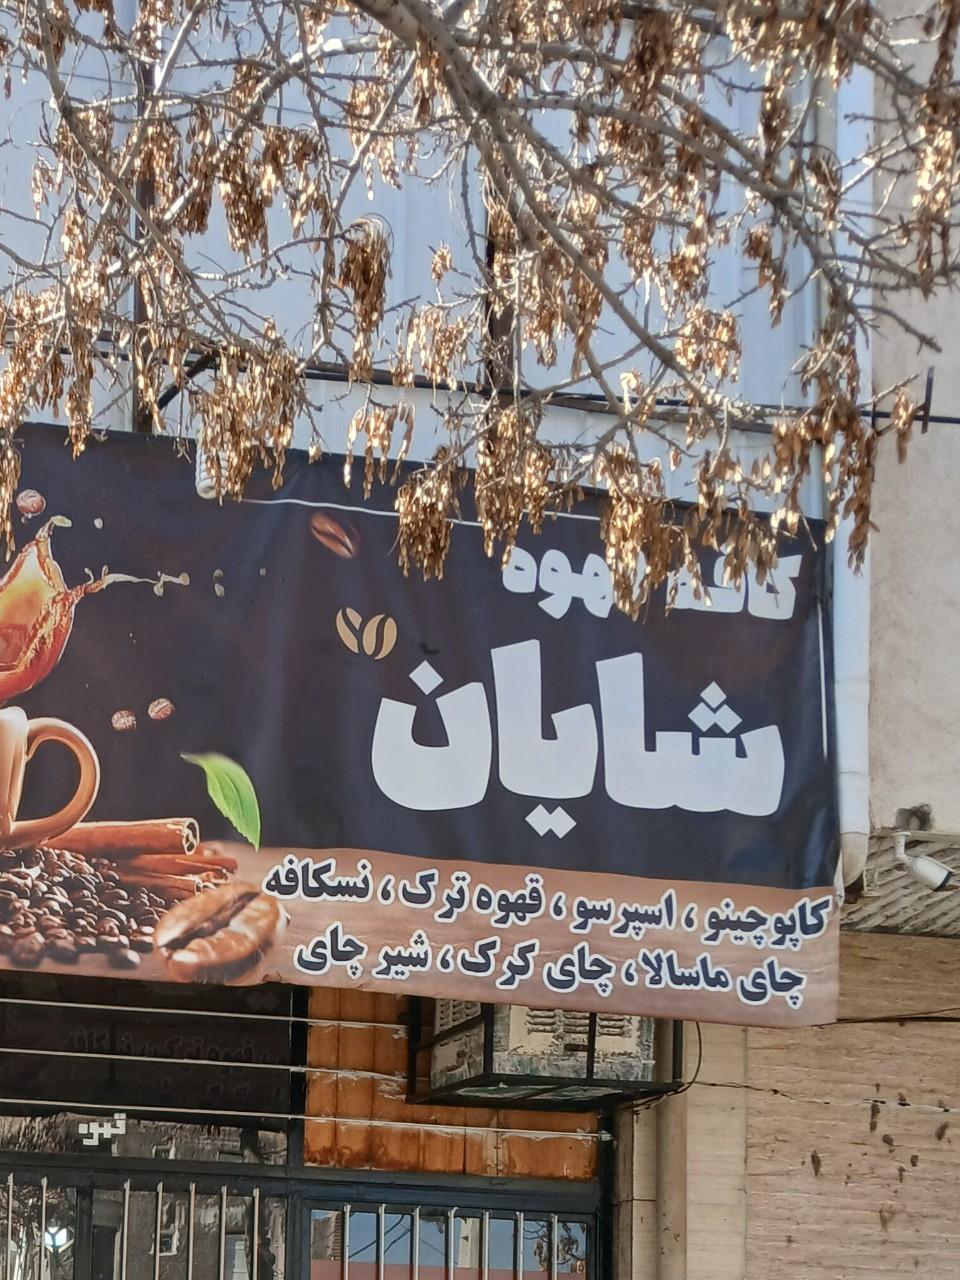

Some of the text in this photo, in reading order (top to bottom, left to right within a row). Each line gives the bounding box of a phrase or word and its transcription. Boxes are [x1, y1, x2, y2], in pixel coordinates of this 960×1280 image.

[502, 546, 649, 620] هوه
[371, 638, 786, 840] شایان
[264, 856, 371, 900] نسکافه
[400, 872, 468, 920] ترک
[475, 876, 544, 925] قهوه
[571, 892, 675, 937] اسپرسو
[702, 898, 831, 948] کاپوچینو
[296, 925, 367, 976] چای
[374, 932, 430, 977] شیر
[545, 944, 614, 994] چای
[739, 958, 806, 1007] چای
